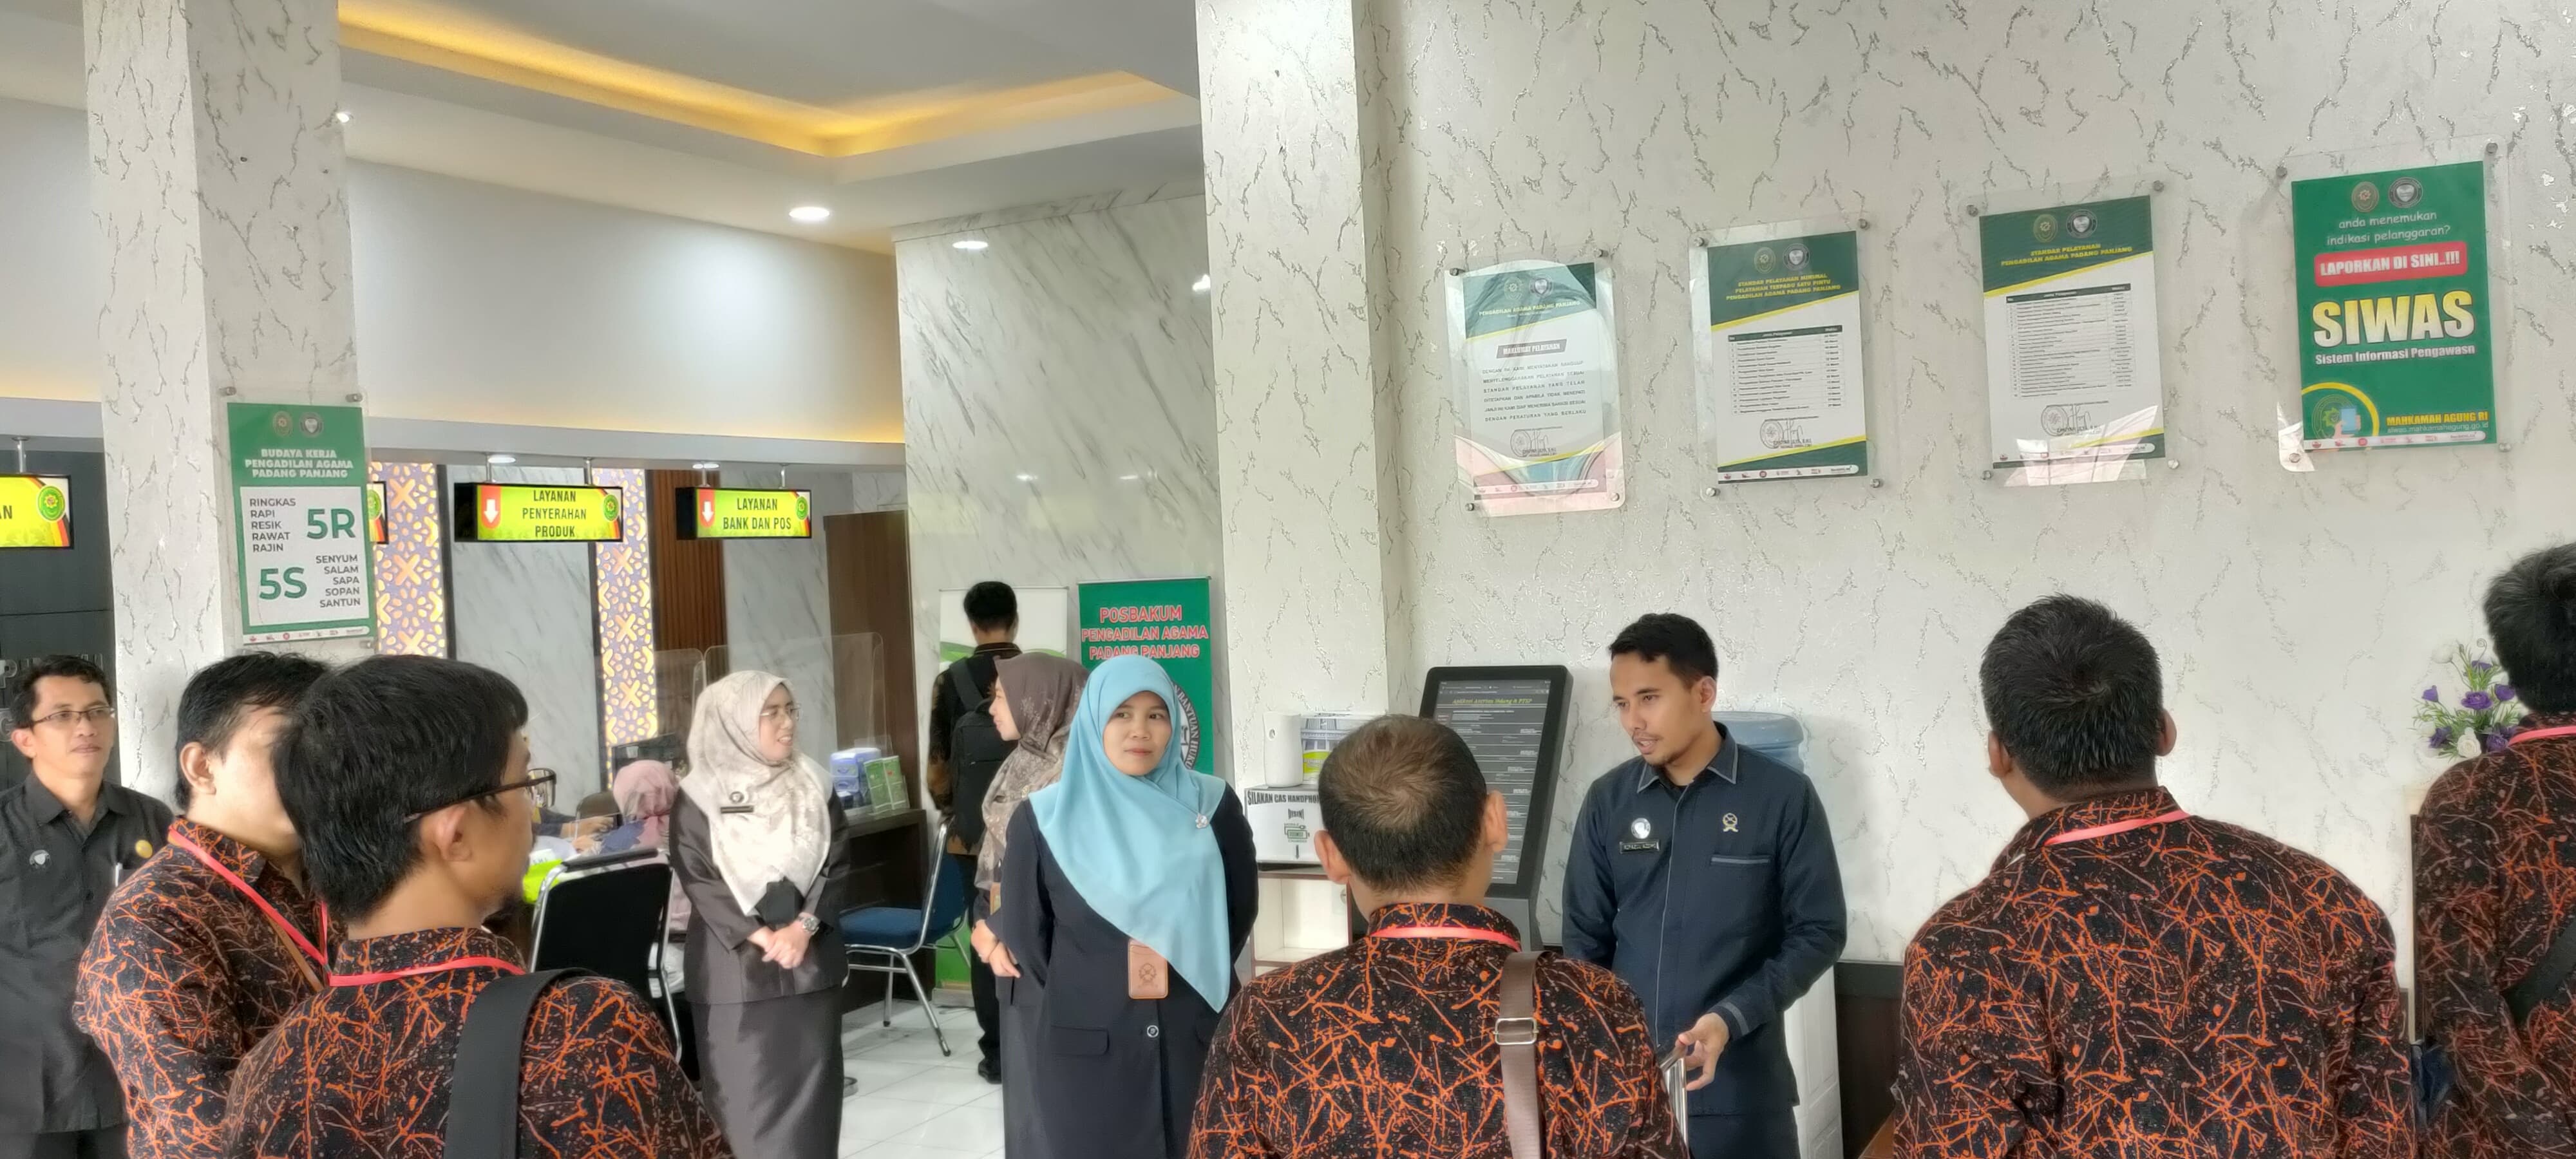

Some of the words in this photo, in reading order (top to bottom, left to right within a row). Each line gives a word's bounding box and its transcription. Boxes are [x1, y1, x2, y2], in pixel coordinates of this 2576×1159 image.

[2339, 218, 2365, 229] anda
[2370, 211, 2437, 226] menemukan
[2327, 233, 2370, 245] indikasi
[2374, 225, 2450, 244] pelanggaran?
[2031, 248, 2061, 256] STANDAR
[2062, 243, 2101, 252] PELAYANAN
[2001, 257, 2043, 266] PENGADILAN
[2044, 254, 2069, 262] AGAMA
[2100, 247, 2132, 255] PANJANG
[2320, 256, 2390, 276] LAPORKAN
[2393, 255, 2407, 270] DI
[2311, 290, 2475, 348] SIWAS
[2315, 353, 2353, 365] Sistem
[2355, 348, 2409, 363] Informasi
[2410, 344, 2475, 358] Pengawasn
[2386, 414, 2441, 426] MAHKAMAH
[2443, 412, 2476, 423] AGUNG
[2478, 411, 2488, 421] RI
[261, 449, 303, 458] BUDAYA
[305, 449, 337, 458] KERJA
[245, 459, 313, 468] PENGADILAN
[316, 460, 354, 469] AGAMA
[252, 469, 296, 478] PADANG
[299, 469, 348, 478] PANJANG
[249, 498, 296, 507] RINGKAS
[533, 490, 576, 502] LAYANAN
[737, 498, 777, 511] LAYANAN
[251, 509, 275, 518] RAPI
[522, 507, 586, 520] PENYERAHAN
[251, 521, 281, 529] RESIK
[307, 508, 355, 540] 5R
[723, 517, 748, 529] BANK
[752, 517, 770, 529] DAN
[773, 517, 791, 529] POS
[252, 532, 290, 541] RAWAT
[535, 525, 575, 537] PRODUK
[253, 543, 283, 552] RAJIN
[316, 554, 357, 564] SENYUM
[324, 565, 359, 574] SALAM
[260, 567, 307, 600] 5S
[333, 576, 360, 585] SAPA
[325, 587, 360, 596] SOPAN
[319, 598, 361, 608] SANTUN
[1099, 605, 1182, 623] POSBAKUM
[1081, 627, 1159, 642] PENGADILAN
[1162, 625, 1209, 640] AGAMA
[1090, 645, 1138, 660] PADANG
[1141, 644, 1200, 659] PANJANG
[1177, 692, 1199, 739] BANTUAN
[1185, 740, 1198, 769] HUKU
[1247, 791, 1273, 806] SILAKAN
[1275, 794, 1286, 803] CAS
[1288, 809, 1304, 820] DISINI
